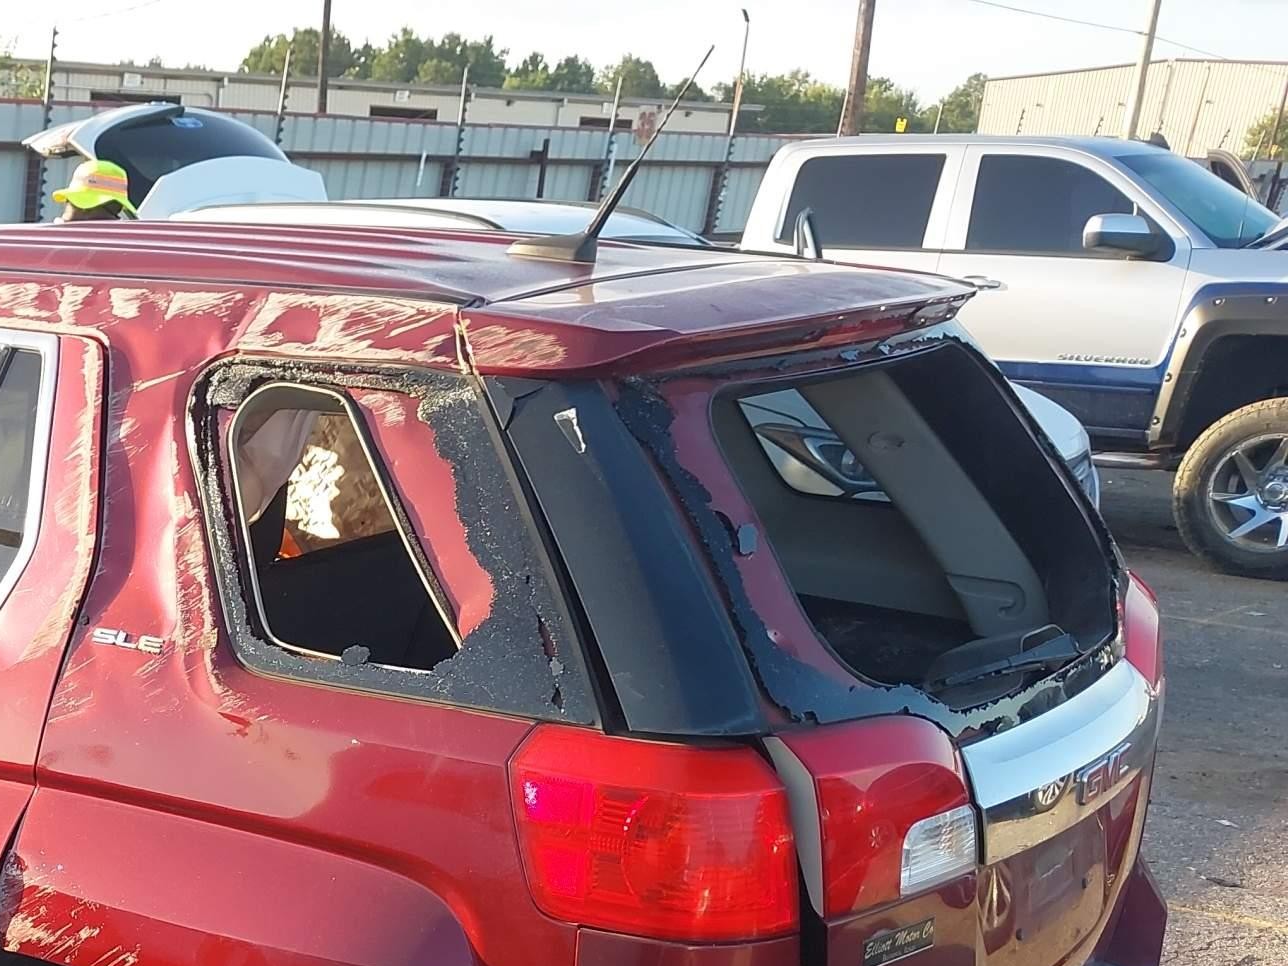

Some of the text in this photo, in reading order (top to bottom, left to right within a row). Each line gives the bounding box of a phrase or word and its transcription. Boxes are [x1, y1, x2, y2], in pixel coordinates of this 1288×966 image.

[92, 627, 164, 655] SLE
[1076, 742, 1132, 805] GMC
[864, 939, 891, 960] Elliott
[895, 929, 920, 946] Motor
